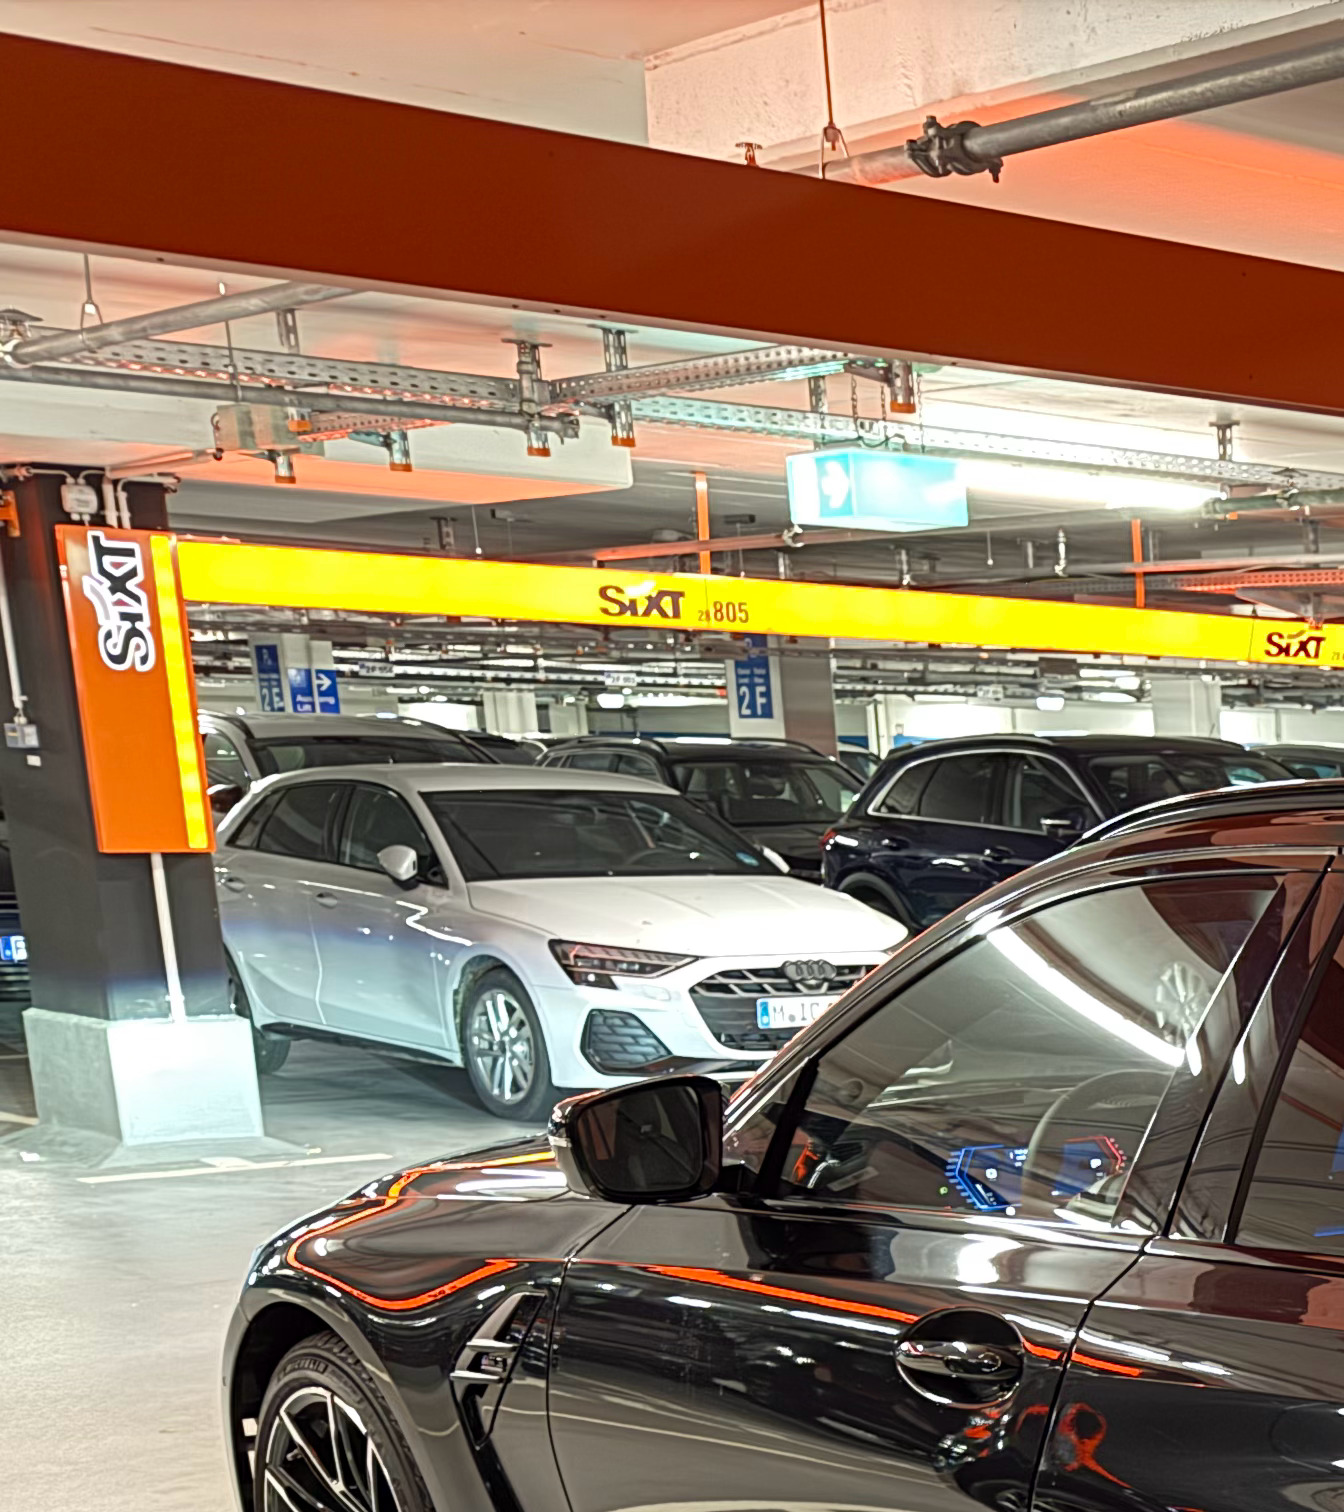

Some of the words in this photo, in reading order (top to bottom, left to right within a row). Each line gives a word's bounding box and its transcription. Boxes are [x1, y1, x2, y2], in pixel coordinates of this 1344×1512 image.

[713, 601, 749, 623] 805
[739, 685, 752, 715] 2
[755, 685, 767, 715] F
